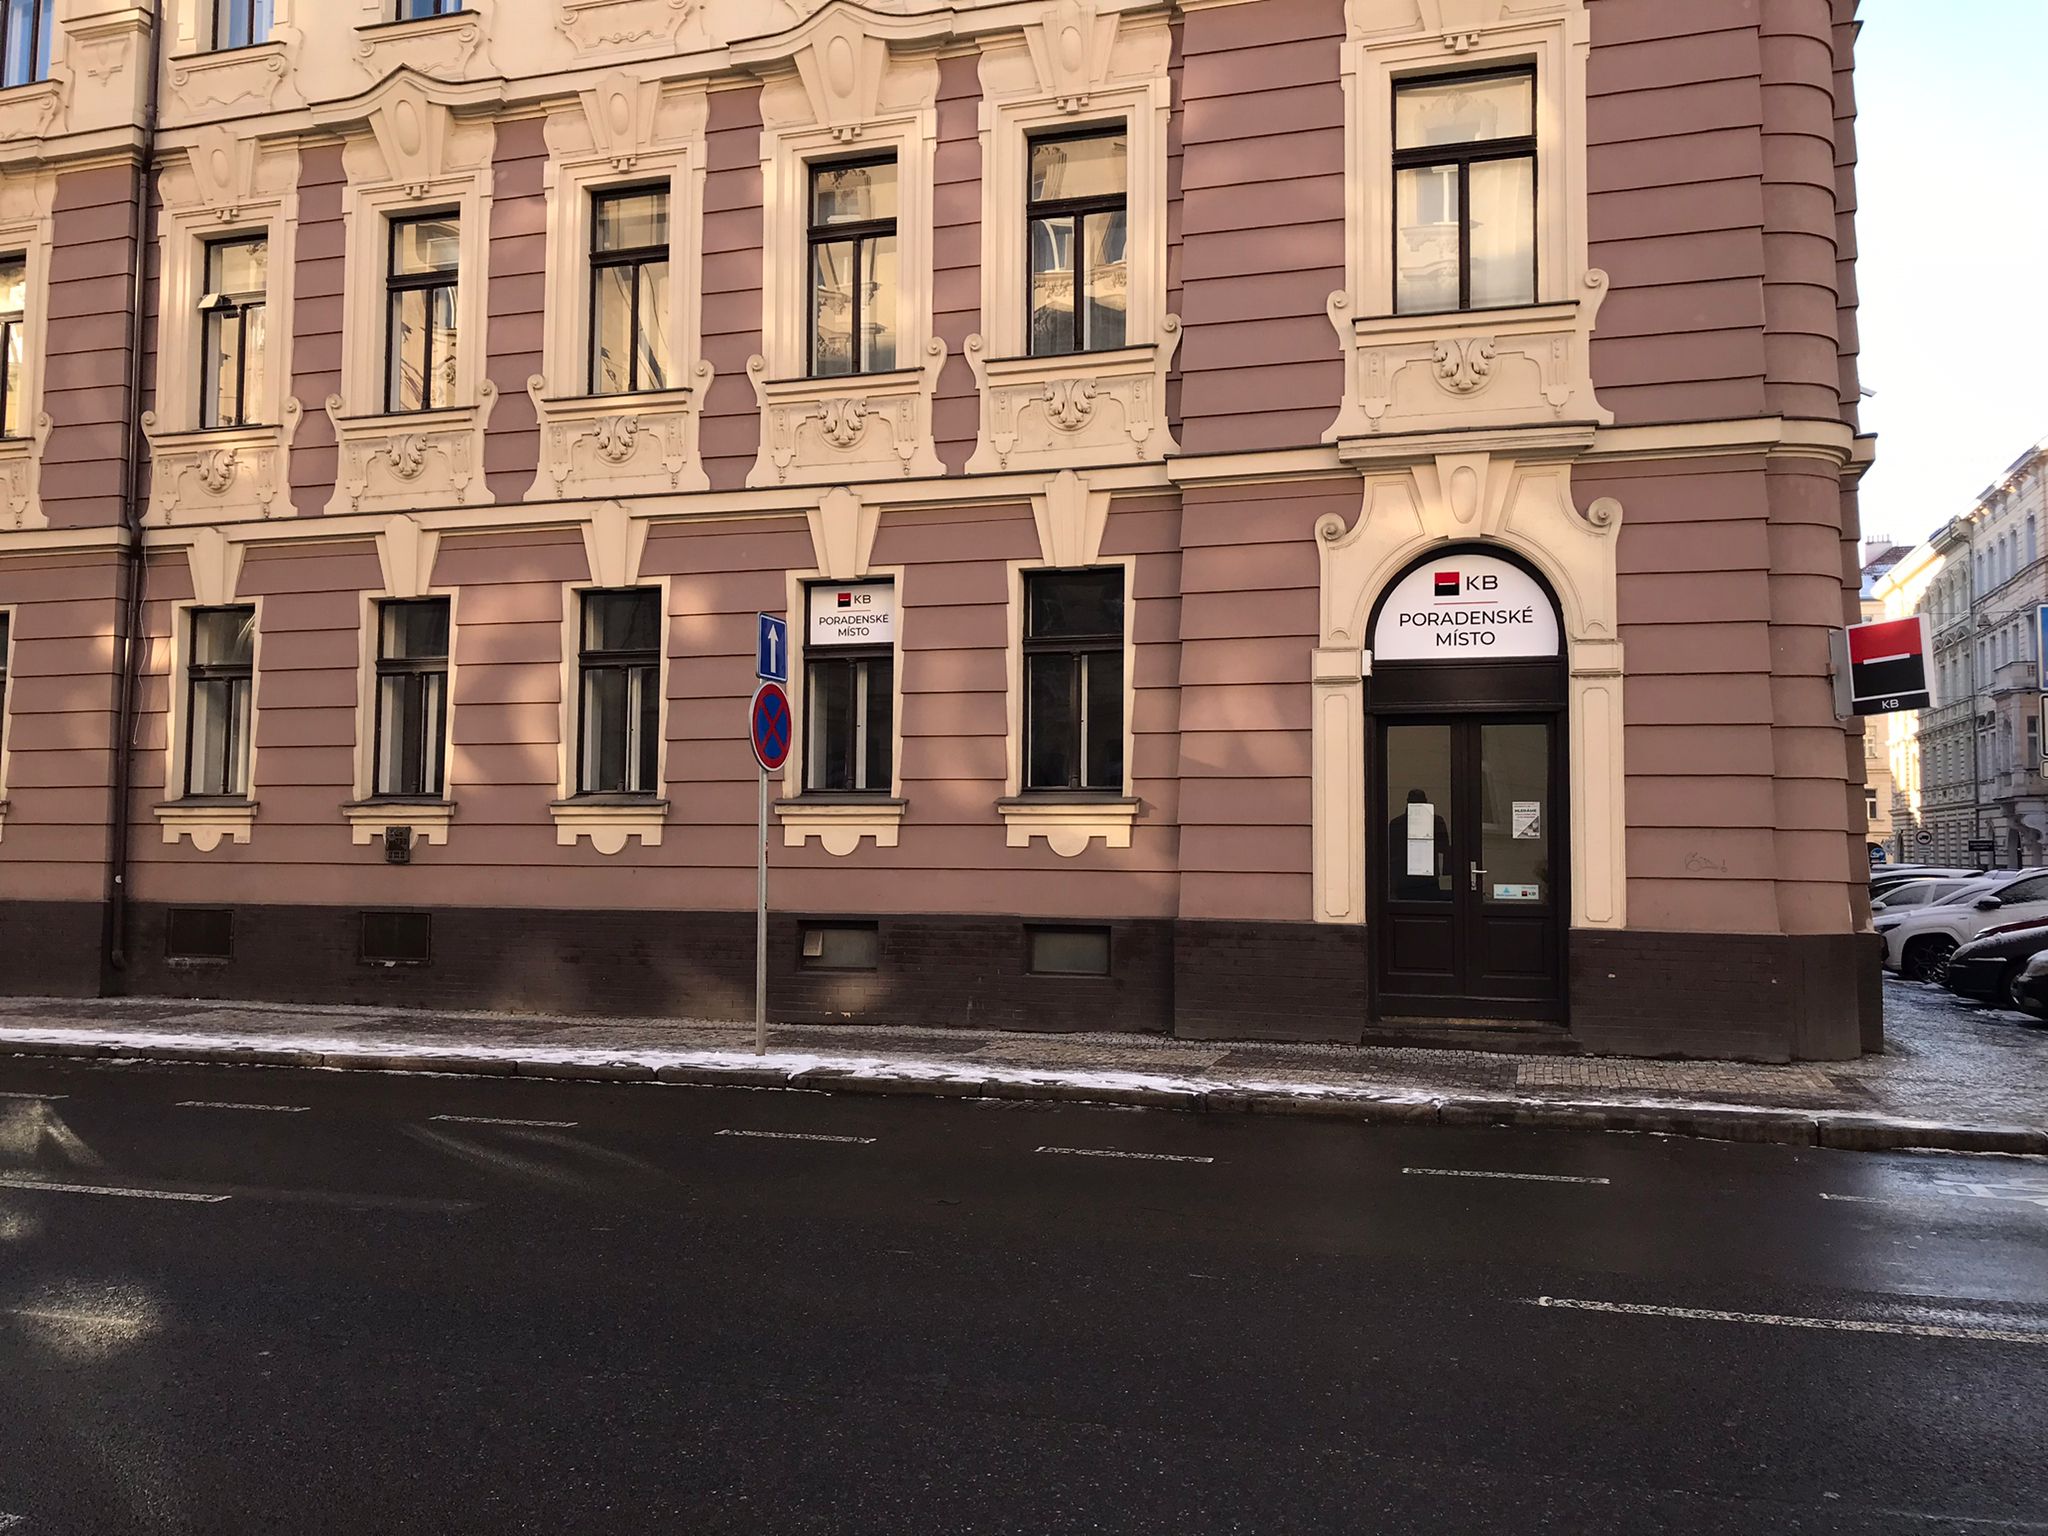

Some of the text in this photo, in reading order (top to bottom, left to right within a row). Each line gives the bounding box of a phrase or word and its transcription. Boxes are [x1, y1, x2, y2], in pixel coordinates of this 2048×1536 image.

[1466, 574, 1499, 591] KB
[853, 594, 872, 605] KB
[818, 613, 889, 625] PORADENSKÉ
[1399, 605, 1534, 627] PORADENSKÉ
[837, 626, 870, 637] MÍSTO
[1436, 628, 1496, 647] MÍSTO
[1881, 698, 1900, 710] KB
